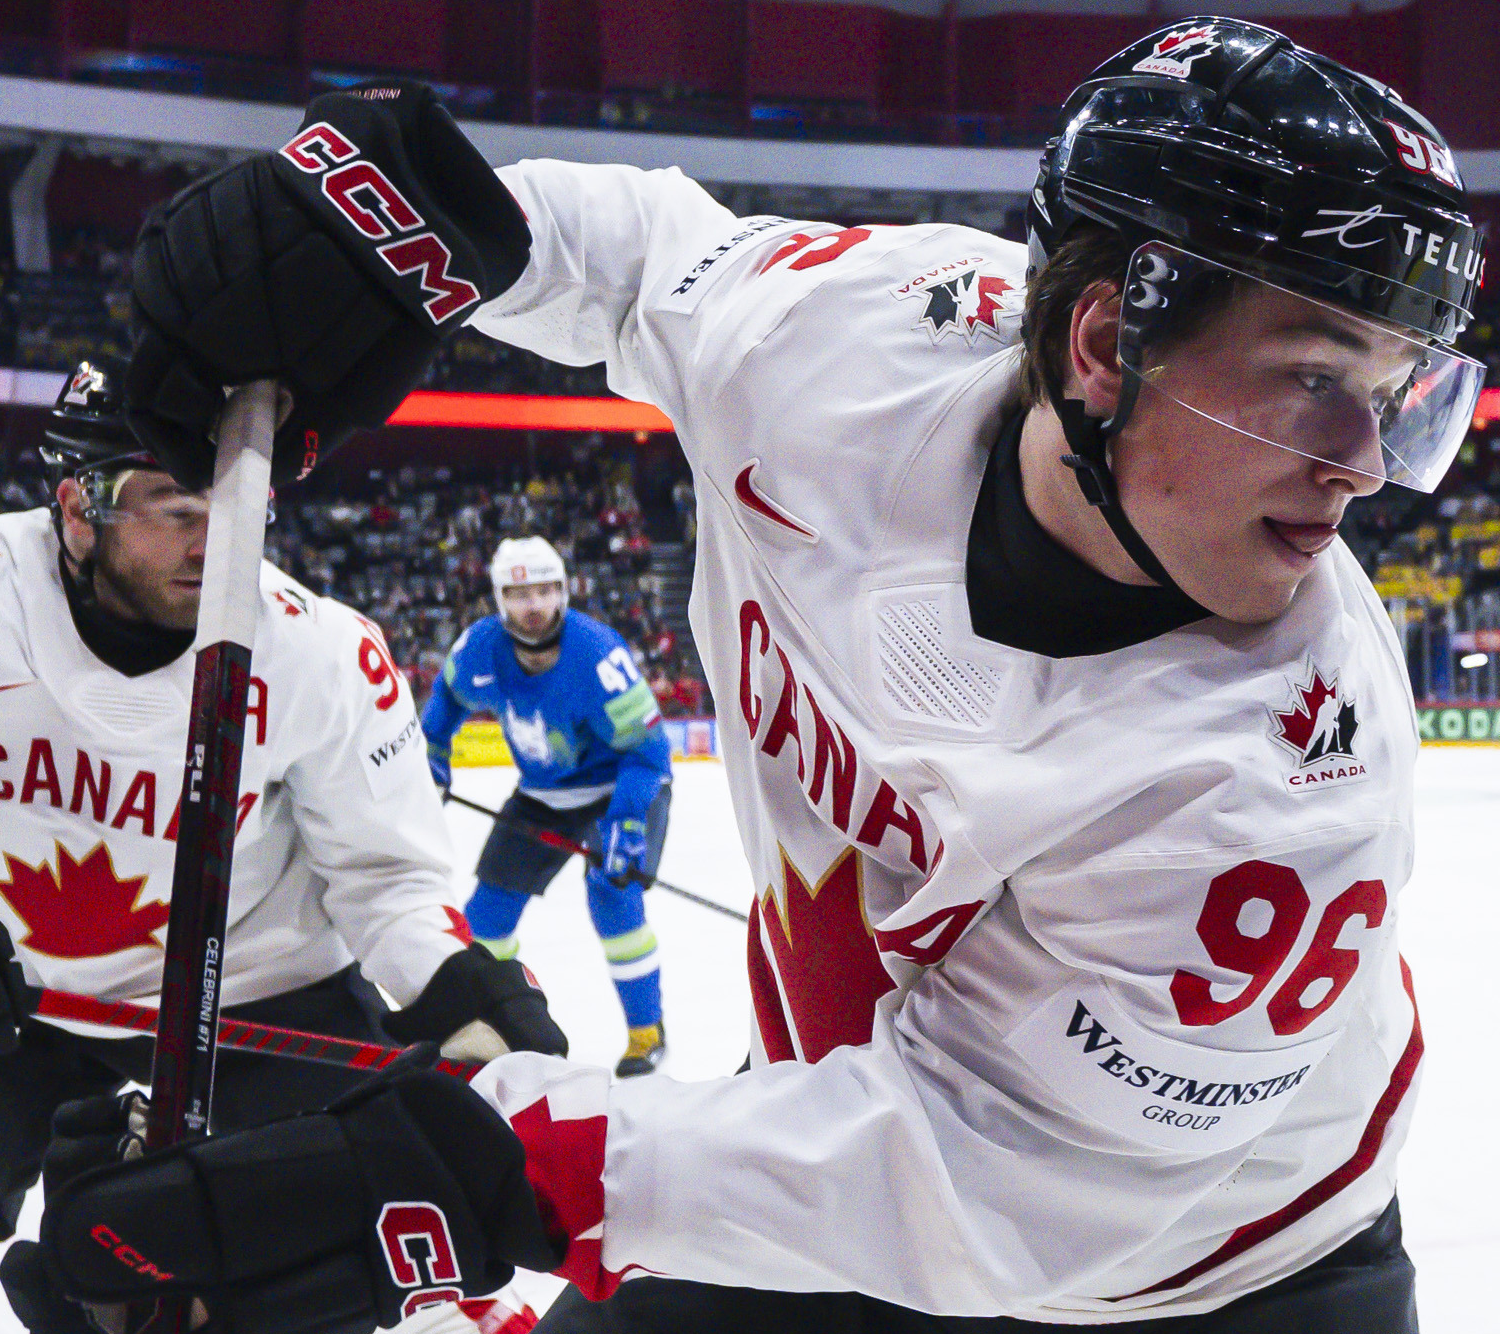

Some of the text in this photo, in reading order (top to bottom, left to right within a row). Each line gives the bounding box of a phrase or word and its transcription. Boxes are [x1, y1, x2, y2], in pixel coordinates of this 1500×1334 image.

[1136, 62, 1186, 77] CANADA
[280, 122, 481, 326] CCM
[897, 256, 985, 294] CANADA
[353, 615, 401, 712] 9
[1288, 765, 1367, 786] CANADA
[1168, 859, 1387, 1037] 96
[196, 937, 220, 1054] CELEBRINI #71
[1065, 999, 1312, 1108] WESTMINSTER
[1141, 1104, 1222, 1132] GROUP
[90, 1223, 175, 1282] CCM
